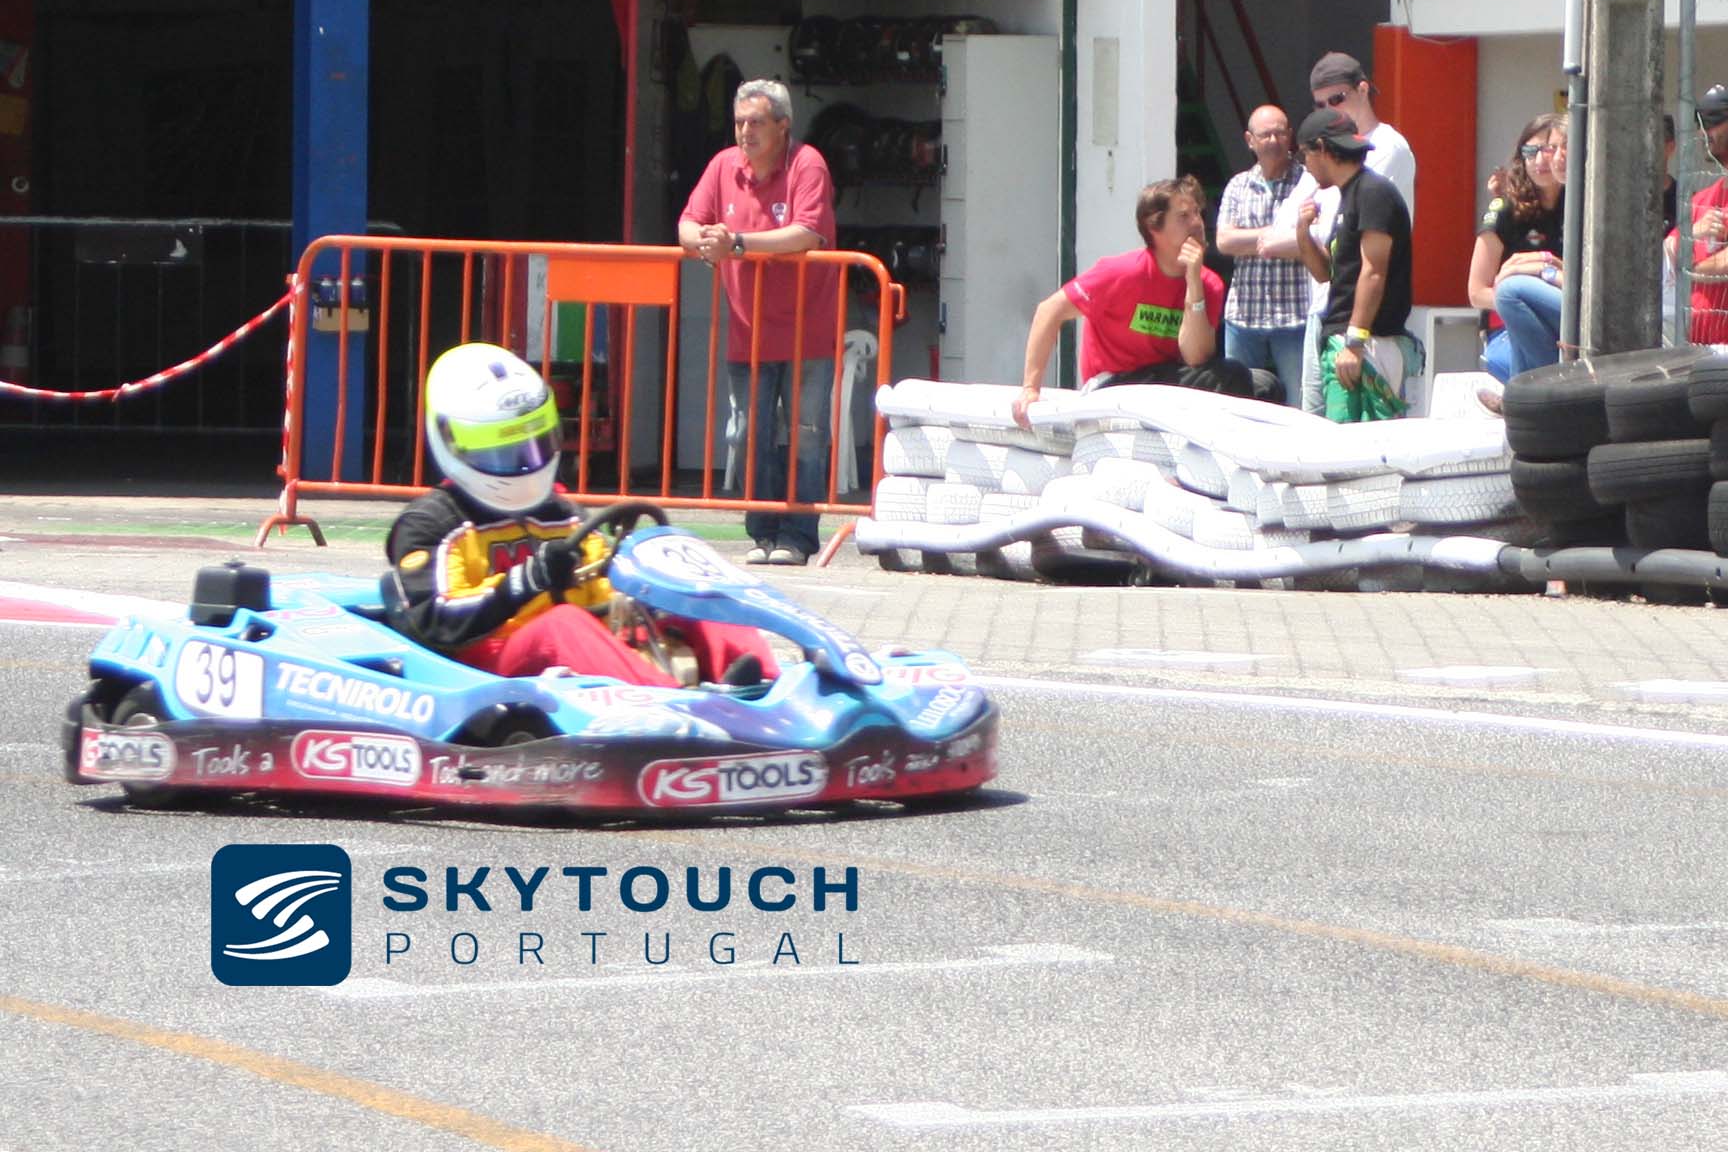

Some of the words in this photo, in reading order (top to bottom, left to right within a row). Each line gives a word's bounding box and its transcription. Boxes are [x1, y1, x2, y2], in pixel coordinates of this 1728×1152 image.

[196, 645, 238, 708] 39
[275, 662, 435, 723] TECNIROLO
[193, 746, 251, 776] Tools
[302, 739, 354, 770] KS
[353, 746, 414, 773] TOOLS
[534, 759, 603, 784] more
[652, 767, 717, 800] KS
[717, 759, 814, 791] TOOLS
